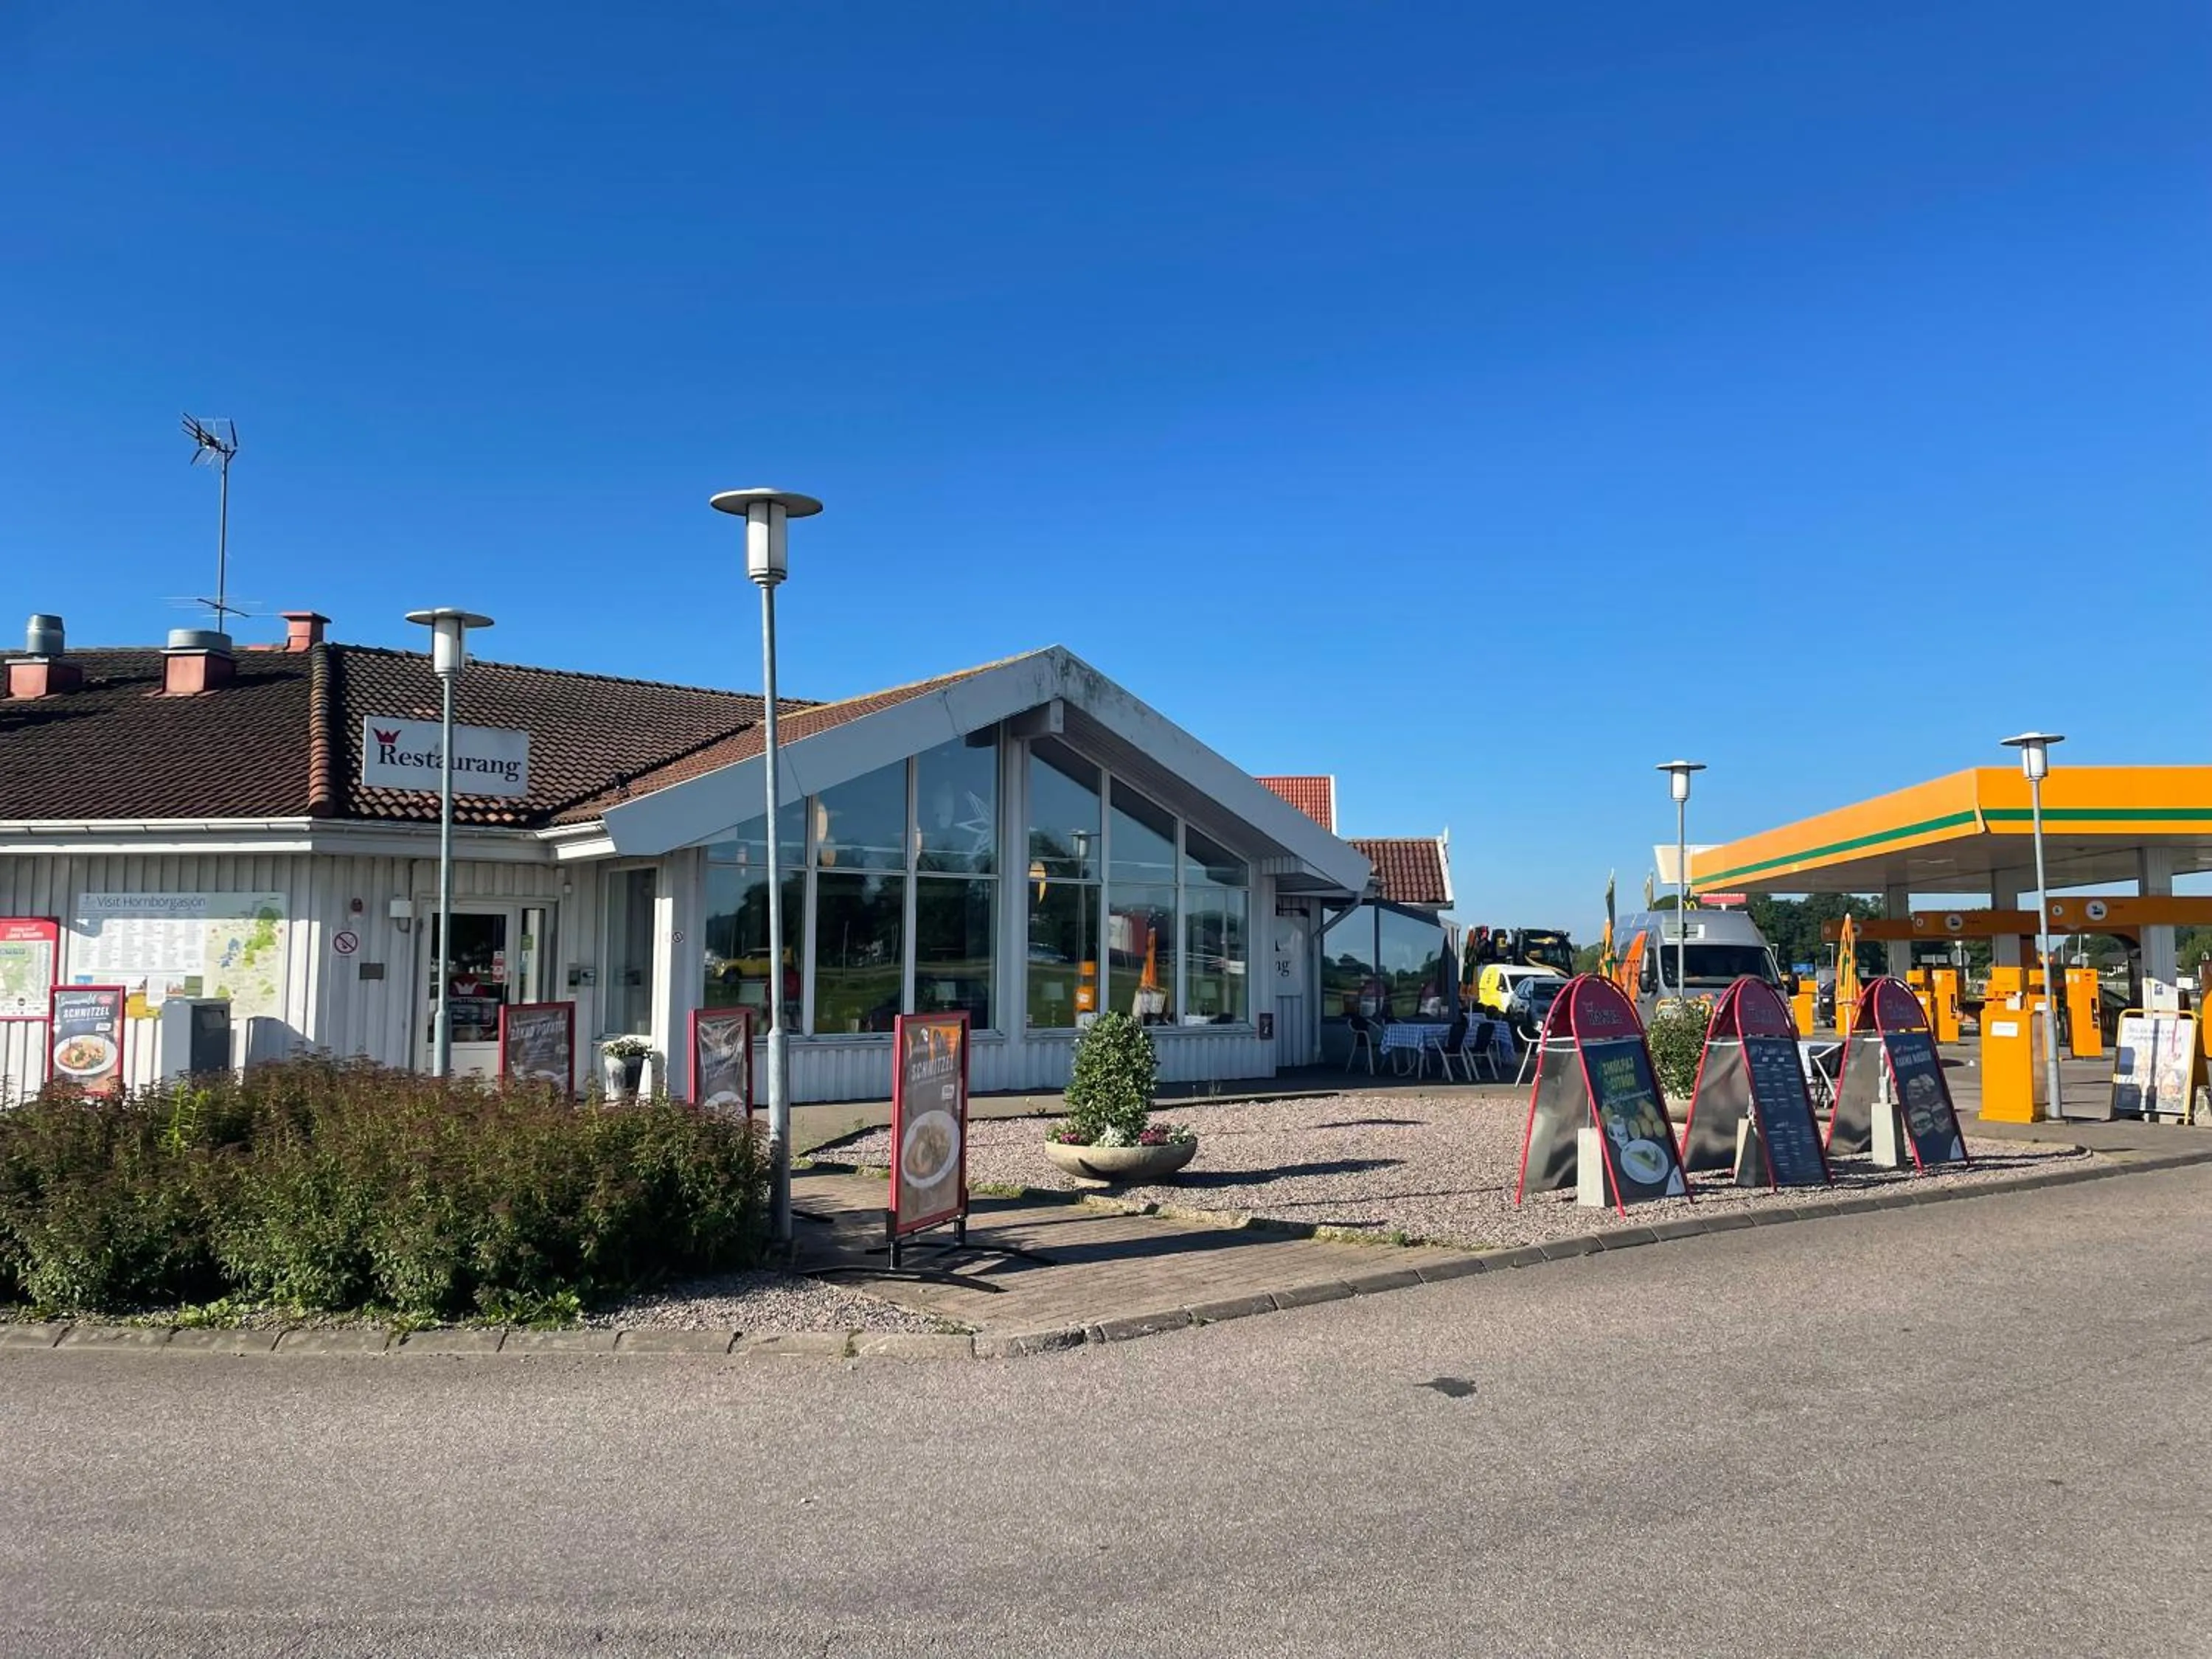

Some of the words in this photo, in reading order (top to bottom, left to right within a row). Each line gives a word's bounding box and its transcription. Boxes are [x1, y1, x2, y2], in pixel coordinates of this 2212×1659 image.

[378, 744, 521, 782] Restaurang
[97, 895, 119, 908] Visit
[63, 1006, 110, 1019] SCHNITZEL
[911, 1054, 954, 1082] SCHNITZEL
